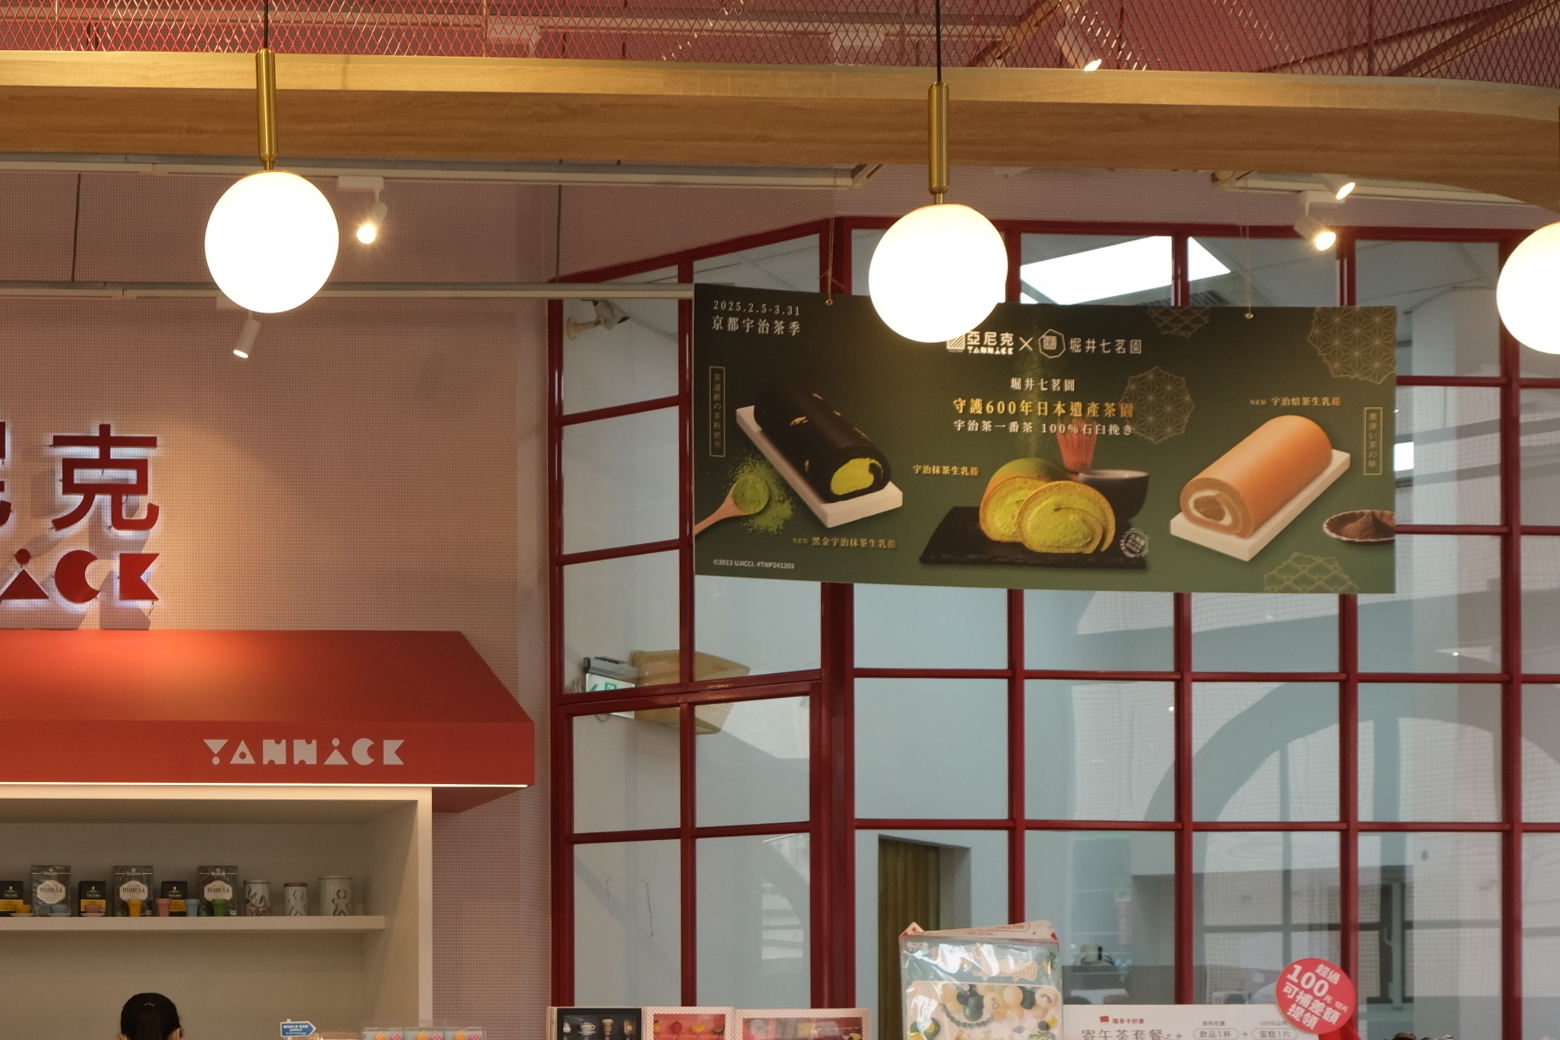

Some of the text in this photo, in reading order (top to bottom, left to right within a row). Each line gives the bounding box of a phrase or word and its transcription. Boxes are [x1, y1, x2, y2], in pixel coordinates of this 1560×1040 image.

[713, 300, 800, 316] 2025.2.5-3.31
[712, 315, 801, 337] 京都宇治茶季
[966, 331, 1014, 347] 亞尼克
[953, 397, 1135, 418] 守護600年日本遺產茶園
[953, 419, 1133, 436] 宇治茶一番茶 100%石臼挽き
[204, 737, 406, 767] YANNICK
[1315, 963, 1342, 985] 超過
[1282, 981, 1342, 1025] 可補差額
[1286, 1003, 1319, 1030] 提領
[1199, 1030, 1292, 1039] 飲品1杯 蛋糕1片
